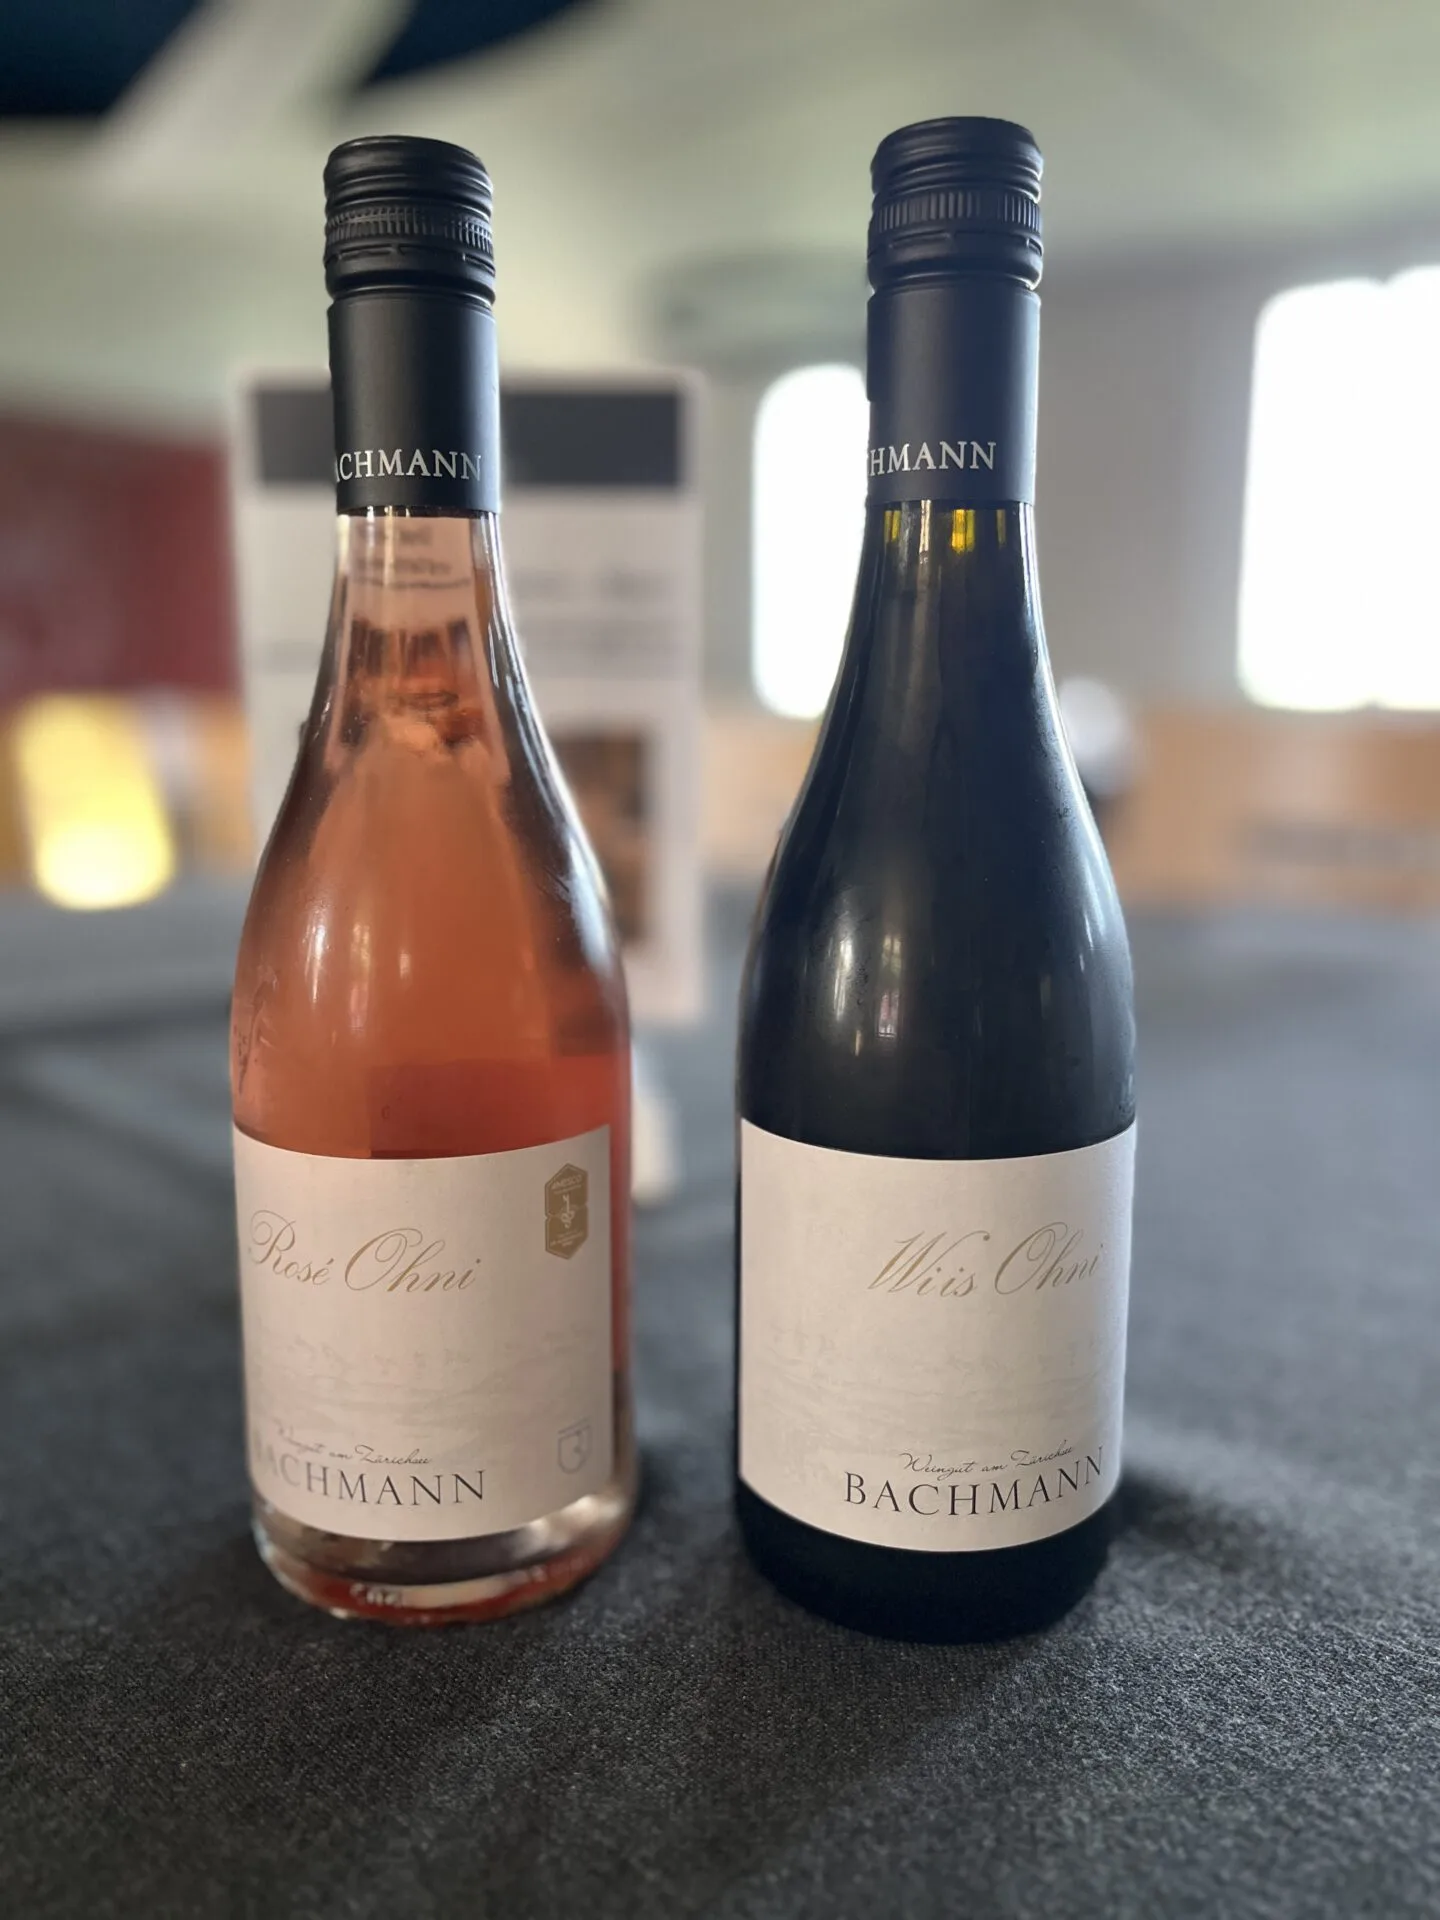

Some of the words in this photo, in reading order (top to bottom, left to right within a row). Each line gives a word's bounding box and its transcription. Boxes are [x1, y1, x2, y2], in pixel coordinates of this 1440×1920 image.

[868, 441, 996, 477] HMANN
[250, 1209, 334, 1286] Rosé
[344, 1228, 482, 1293] Ohni
[868, 1231, 990, 1297] Wiis
[994, 1222, 1104, 1295] Ohni
[844, 1445, 1104, 1516] BACHMANN
[899, 1452, 976, 1481] Weingut
[981, 1464, 1008, 1473] am
